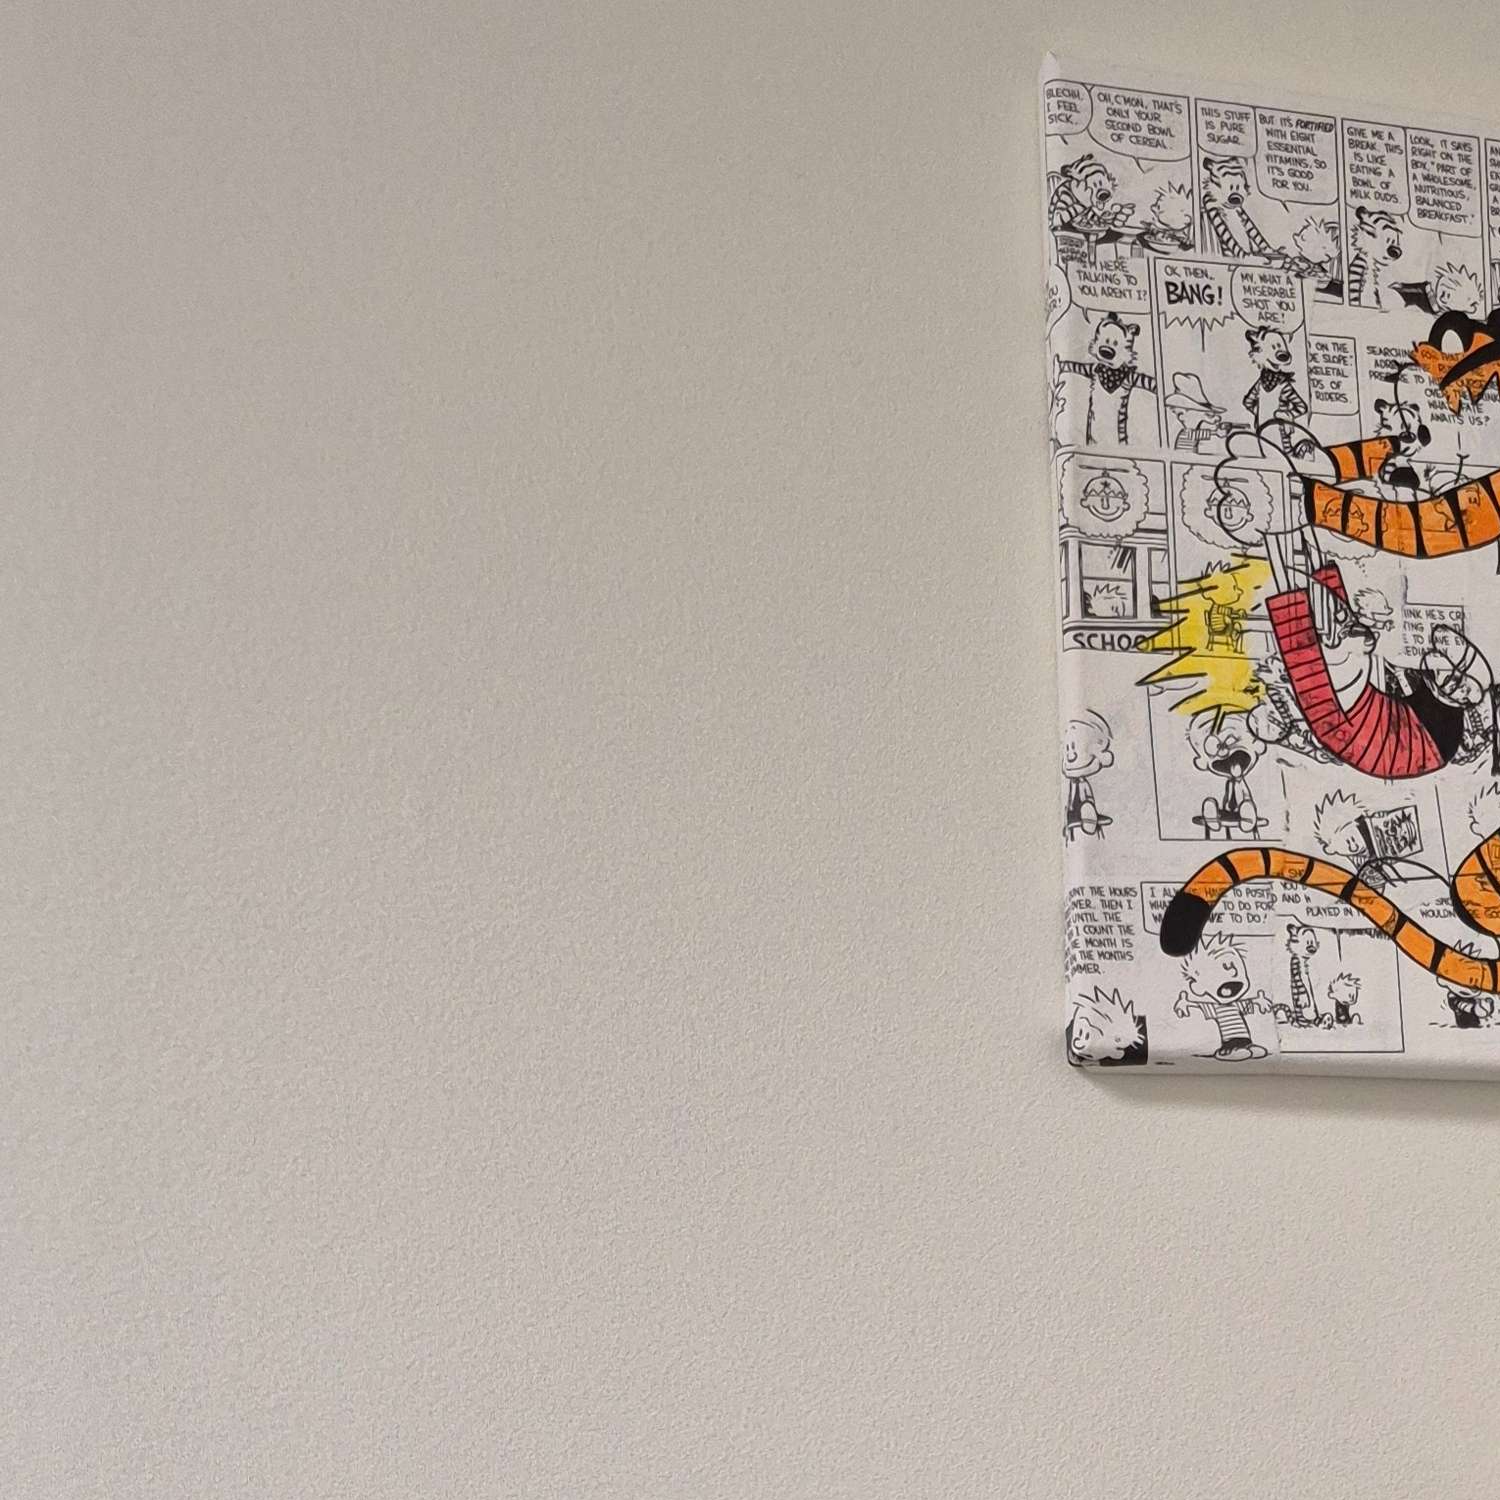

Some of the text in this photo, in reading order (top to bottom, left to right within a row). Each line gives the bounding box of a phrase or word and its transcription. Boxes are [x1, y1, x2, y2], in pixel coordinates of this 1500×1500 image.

[1057, 100, 1080, 113] FEEL
[1106, 107, 1162, 123] ONLY YOUR
[1201, 107, 1250, 122] THIS STUFF
[1105, 119, 1175, 138] SECOND BOWL
[1205, 120, 1245, 134] IS PURE
[1259, 113, 1274, 125] BUT
[1295, 118, 1335, 132] FORTIFIED
[1110, 132, 1125, 143] OF
[1266, 128, 1316, 143] WITH EIGHT
[1347, 126, 1395, 141] GIVE ME A
[1266, 141, 1318, 156] ESSENTIAL
[1384, 143, 1404, 155] THIS
[1440, 139, 1448, 149] IT
[1450, 141, 1473, 152] SAYS
[1353, 151, 1387, 166] IS LIKE
[1410, 147, 1472, 165] RIGHT ON THE
[1314, 159, 1327, 170] SO
[1287, 168, 1314, 181] GOOD
[1349, 164, 1396, 178] EATING A
[1460, 167, 1472, 177] OF
[1272, 178, 1289, 190] FOR
[1351, 176, 1391, 190] BOWL OF
[1412, 173, 1418, 183] A
[1349, 189, 1372, 200] MILK
[1492, 195, 1499, 204] A
[1415, 195, 1462, 212] BALANCED
[1164, 265, 1181, 277] OK
[1076, 270, 1138, 286] TALKING TO
[1259, 273, 1282, 284] WHAT
[1286, 276, 1293, 285] A
[1165, 281, 1223, 306] BANG!
[1243, 285, 1296, 299] MISERABLE
[1242, 298, 1296, 312] SHOT YOU
[1315, 342, 1349, 353] ON THE
[1330, 380, 1342, 390] OF
[1414, 374, 1425, 384] TO
[1461, 402, 1483, 414] FATE
[1430, 413, 1490, 427] AWAITS US?
[1413, 634, 1424, 645] TO
[1089, 886, 1137, 897] THE HOURS
[1233, 888, 1242, 897] TO
[1282, 893, 1301, 903] AND
[1100, 899, 1133, 910] THEN I
[1222, 901, 1273, 911] TO DO FOR
[1073, 911, 1121, 923] UNTIL THE
[1306, 906, 1352, 917] PLAYED IN
[1229, 913, 1267, 924] TO DO!
[1083, 924, 1113, 935] COUNT
[1117, 924, 1135, 936] THE
[1085, 938, 1133, 949] MONTH IS
[1079, 950, 1135, 961] THE MONTHS
